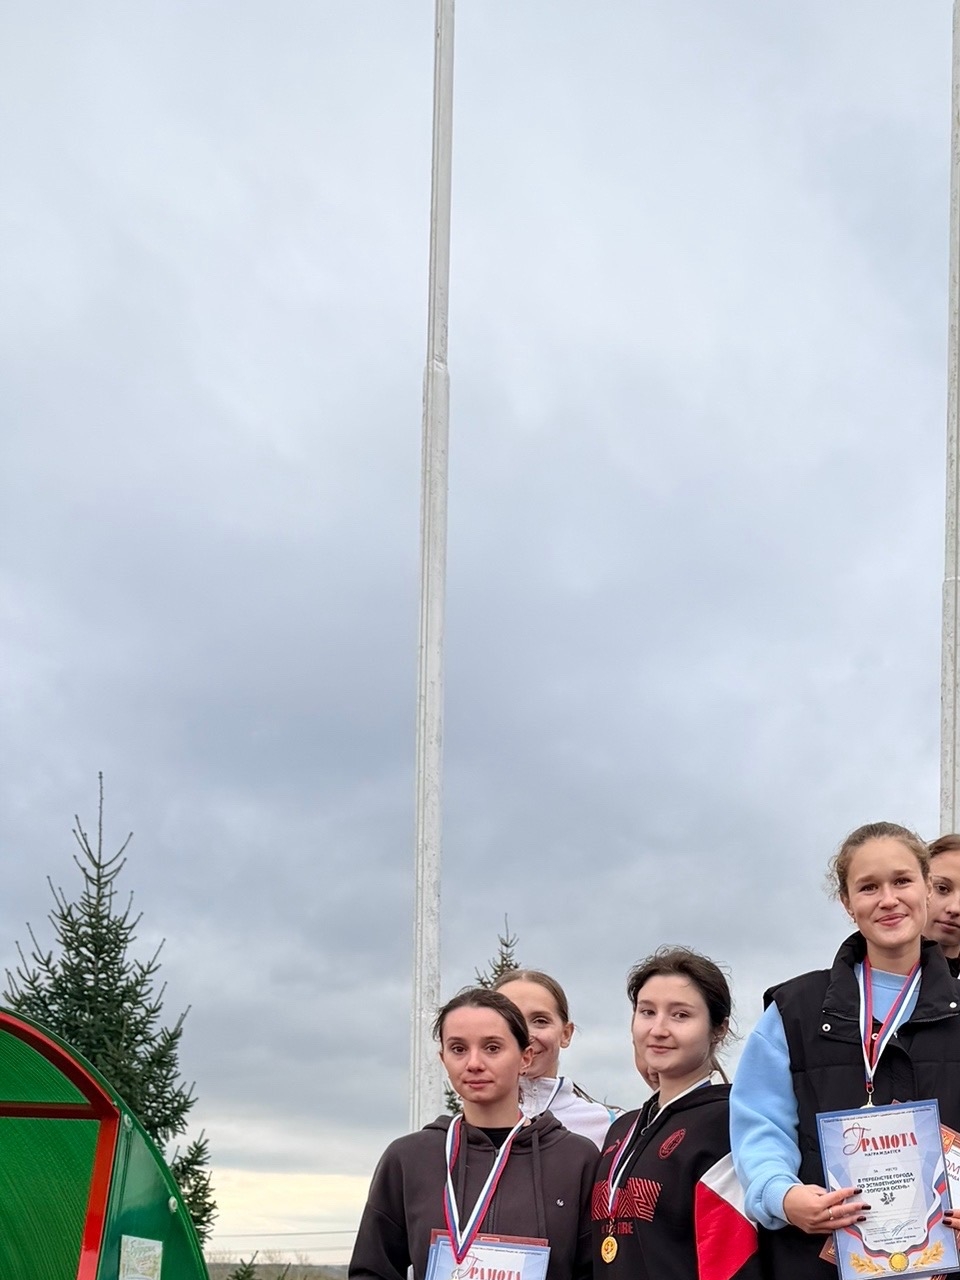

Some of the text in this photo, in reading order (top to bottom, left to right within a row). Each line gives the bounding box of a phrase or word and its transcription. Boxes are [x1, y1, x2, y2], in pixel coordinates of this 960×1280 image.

[842, 1122, 918, 1156] ГРАМОТА
[862, 1175, 892, 1183] ПЕРВЕНСТВЕ
[866, 1179, 902, 1188] ЭСТАФЕТНОМУ
